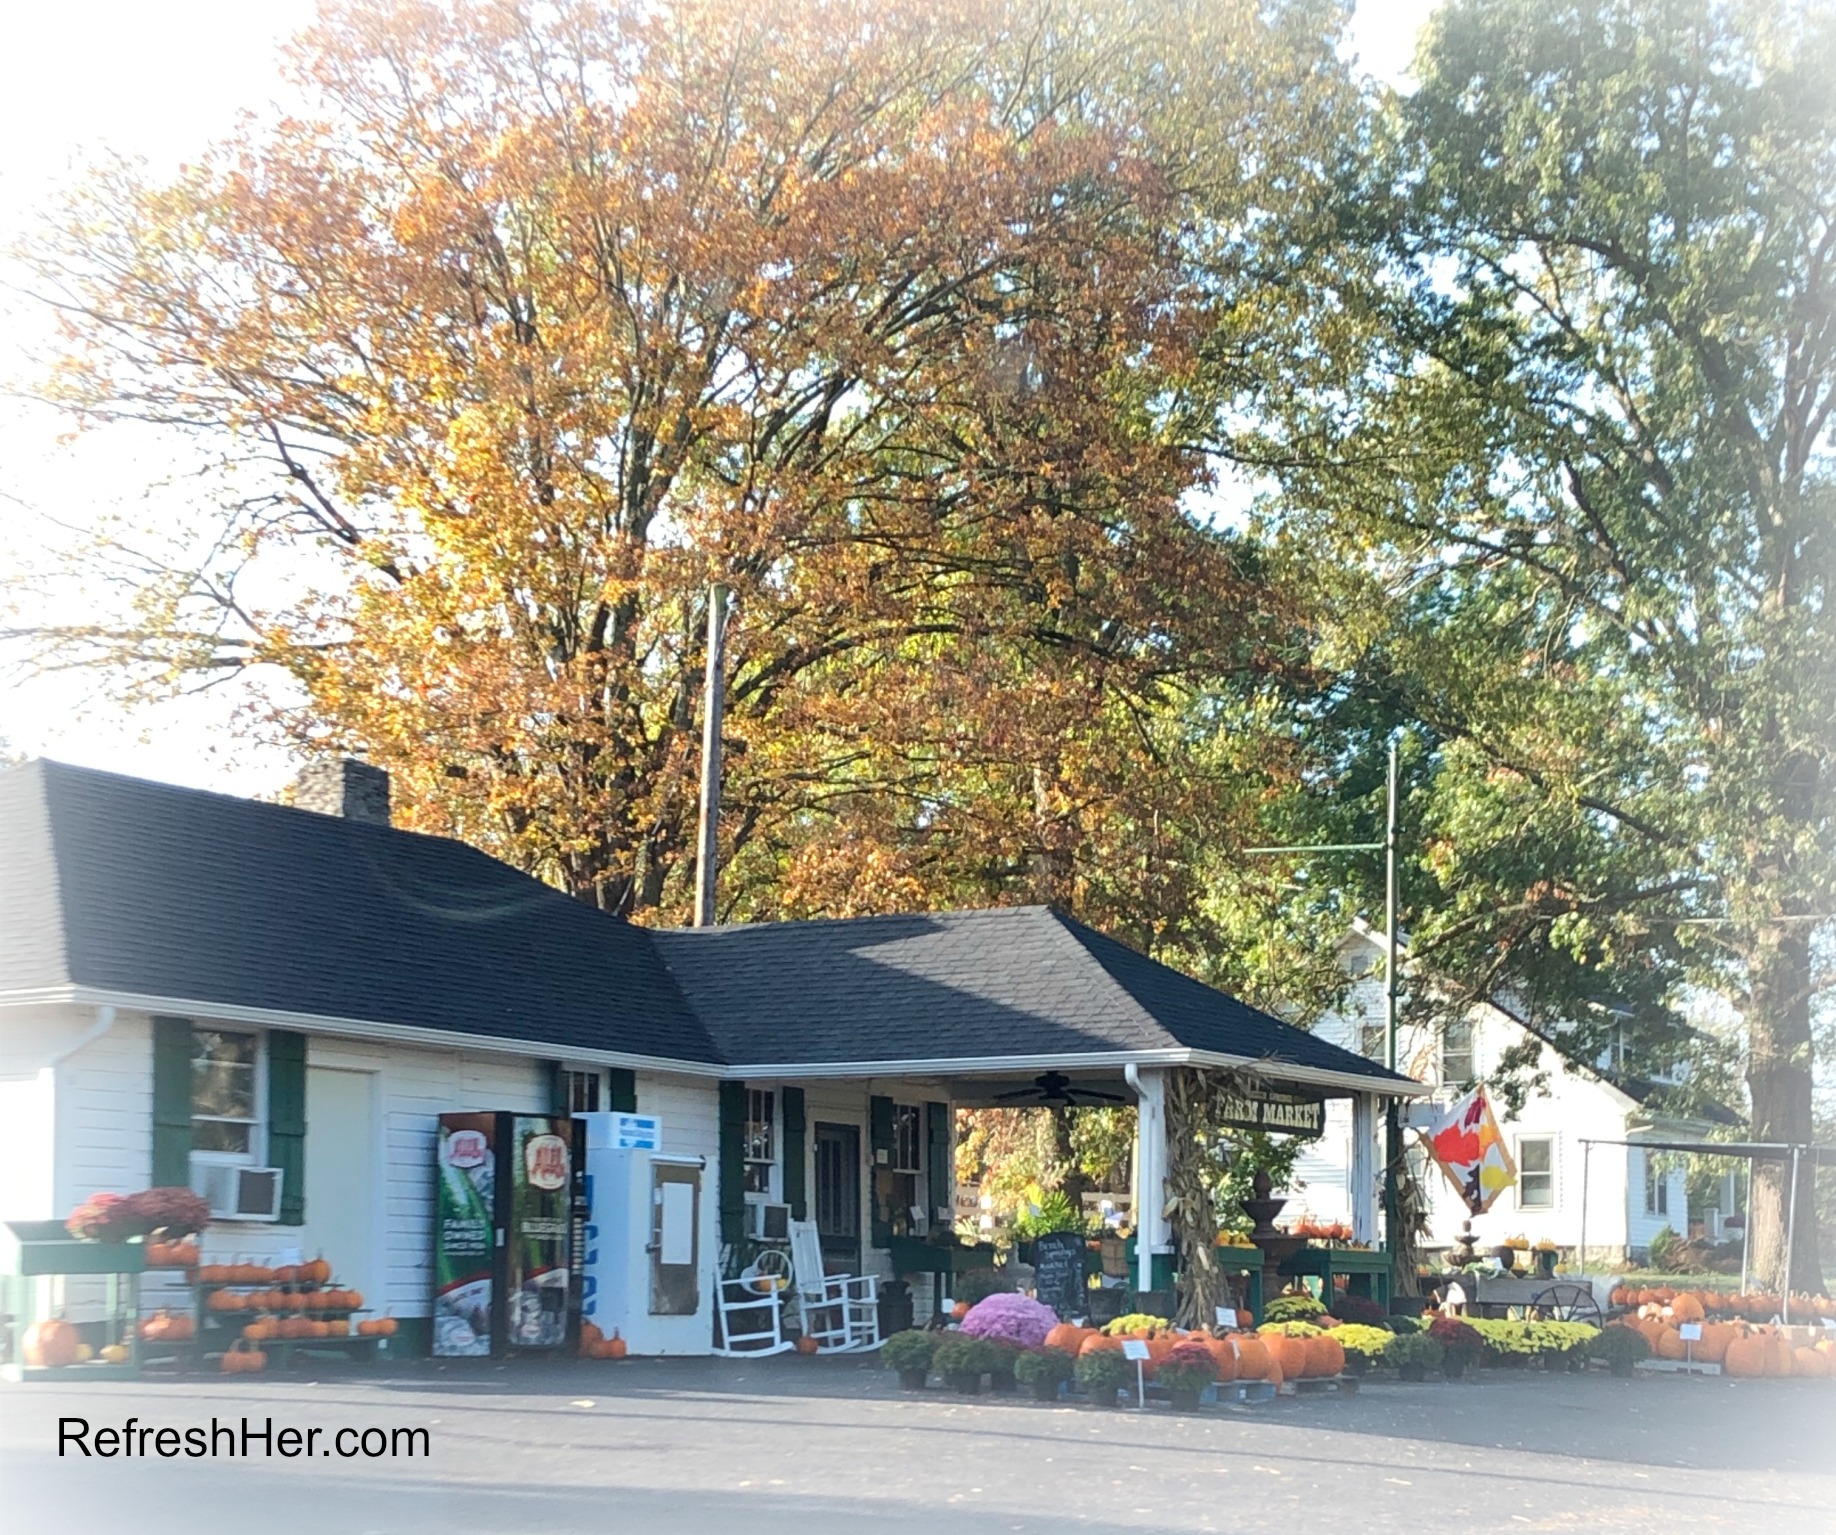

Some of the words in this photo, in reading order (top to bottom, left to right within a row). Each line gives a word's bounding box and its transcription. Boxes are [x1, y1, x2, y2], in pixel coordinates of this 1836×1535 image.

[1215, 1090, 1259, 1123] FARM
[1262, 1102, 1320, 1130] MARKET
[443, 1230, 486, 1241] OWNED
